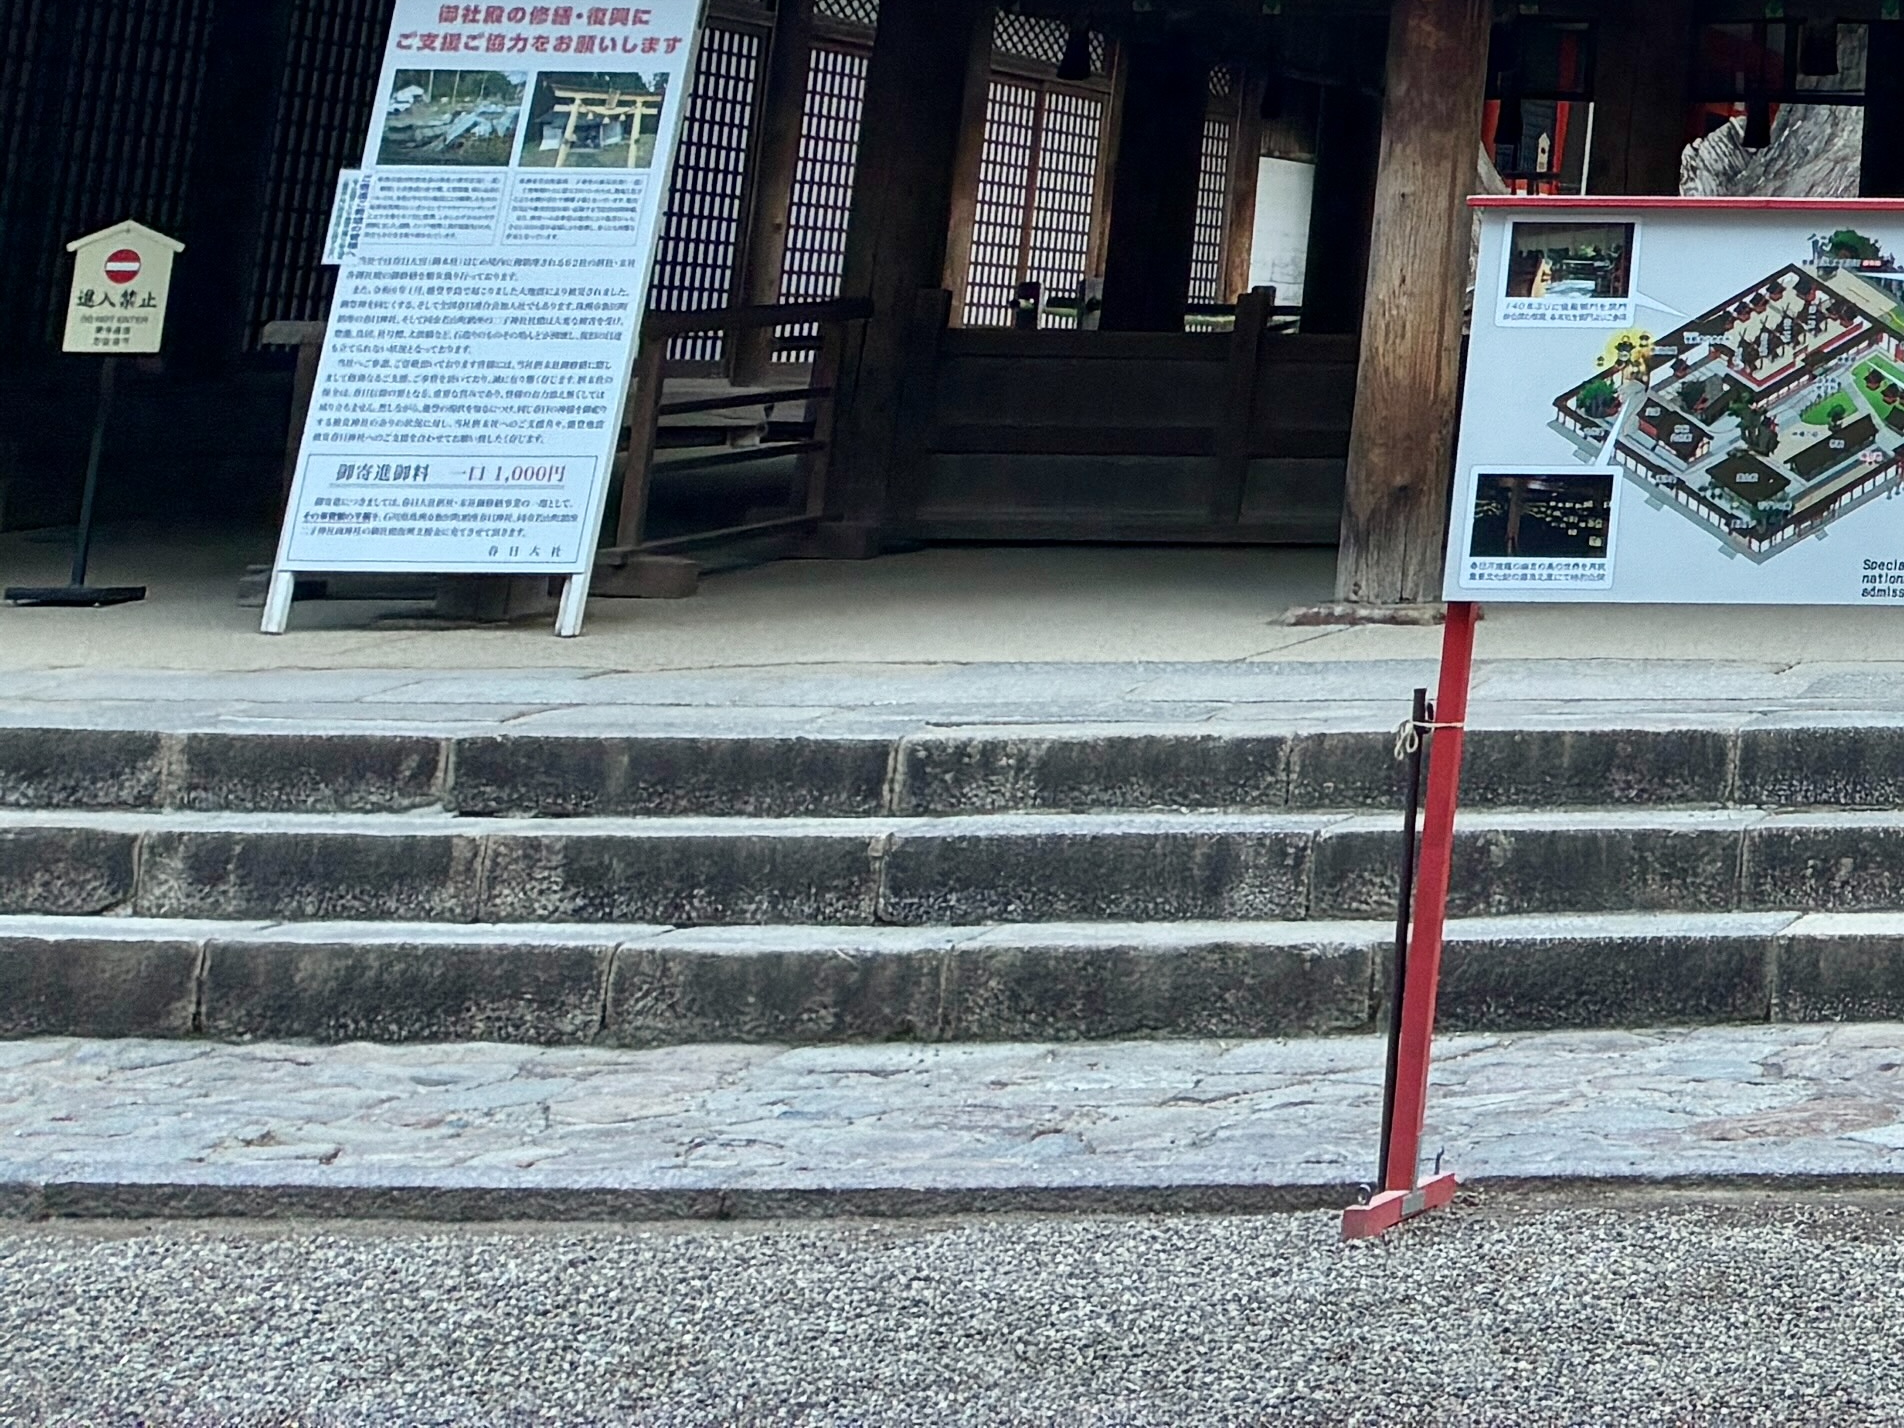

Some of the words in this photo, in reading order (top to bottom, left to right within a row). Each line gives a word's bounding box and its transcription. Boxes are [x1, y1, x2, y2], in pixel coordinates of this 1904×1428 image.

[396, 31, 683, 55] ご支援ご協力をお願いします
[76, 288, 158, 310] 進入禁止
[495, 464, 566, 484] 1,000円
[488, 545, 562, 557] 春日大社
